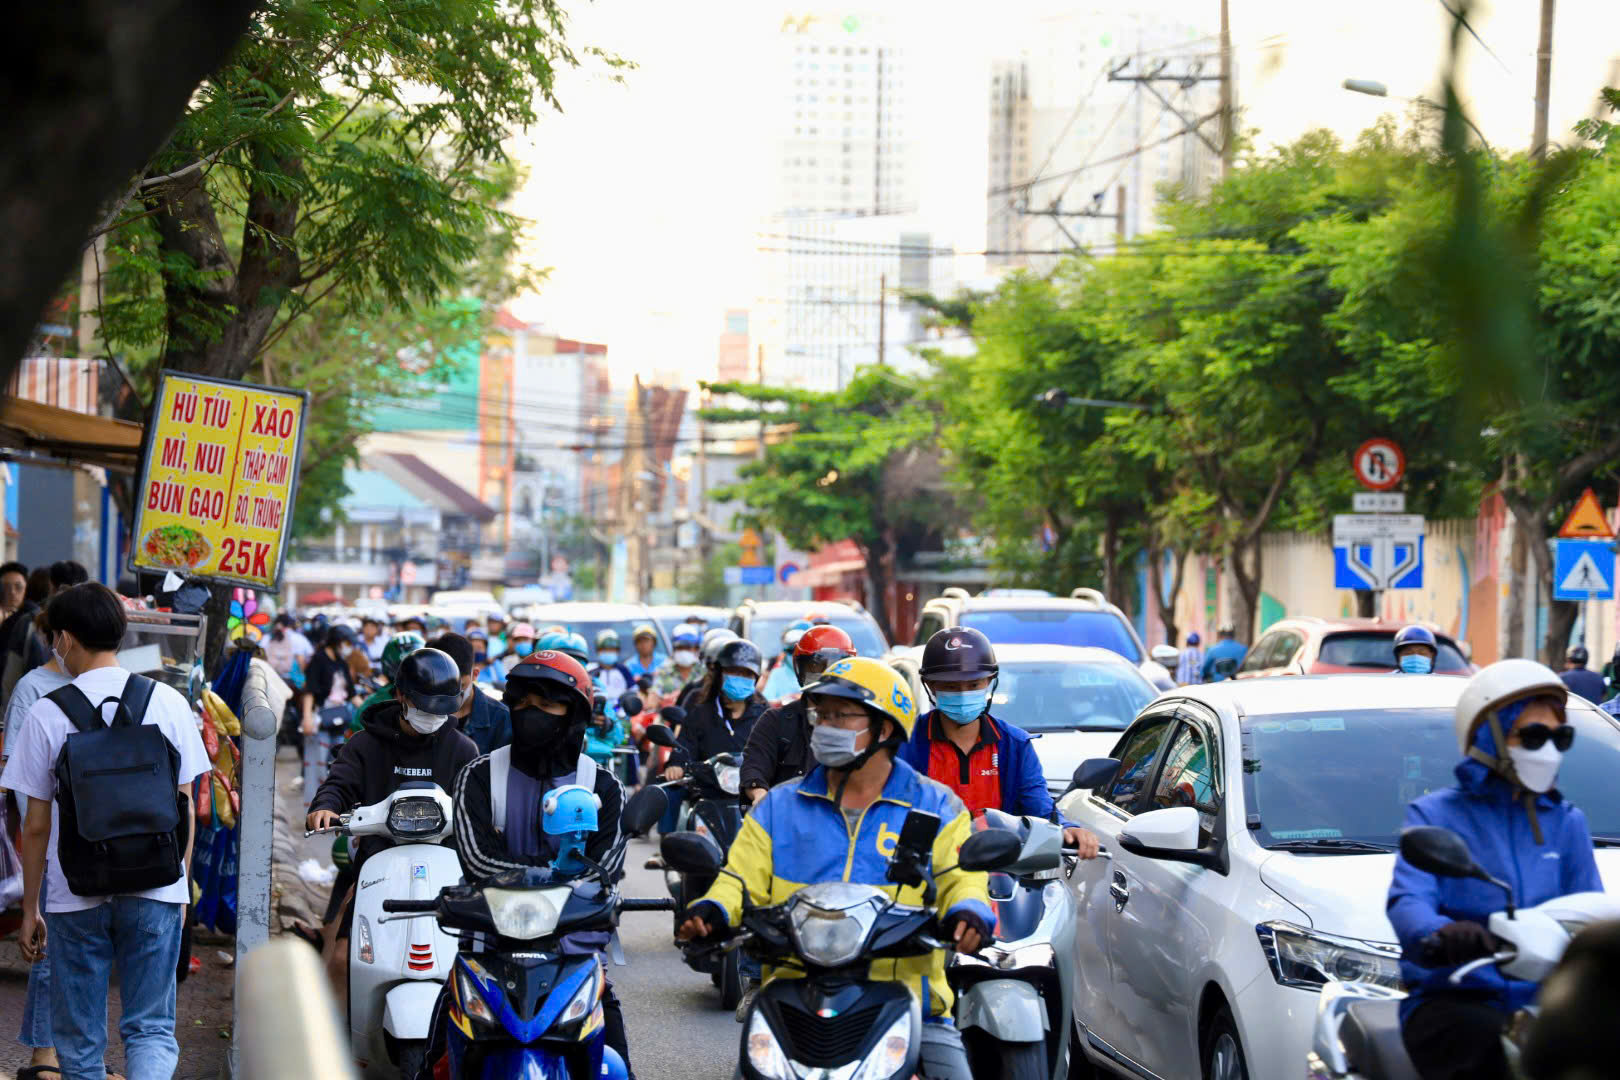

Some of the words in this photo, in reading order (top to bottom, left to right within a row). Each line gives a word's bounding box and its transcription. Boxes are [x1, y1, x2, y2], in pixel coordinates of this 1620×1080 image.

[172, 385, 198, 423] HỦ
[203, 391, 231, 428] TÍU
[251, 400, 294, 438] XÀO
[161, 433, 188, 474] MÌ,
[194, 443, 226, 475] NUI
[147, 476, 184, 513] BÚN
[188, 487, 224, 525] GẠO
[218, 538, 270, 577] 25K
[511, 952, 548, 961] HONDA
